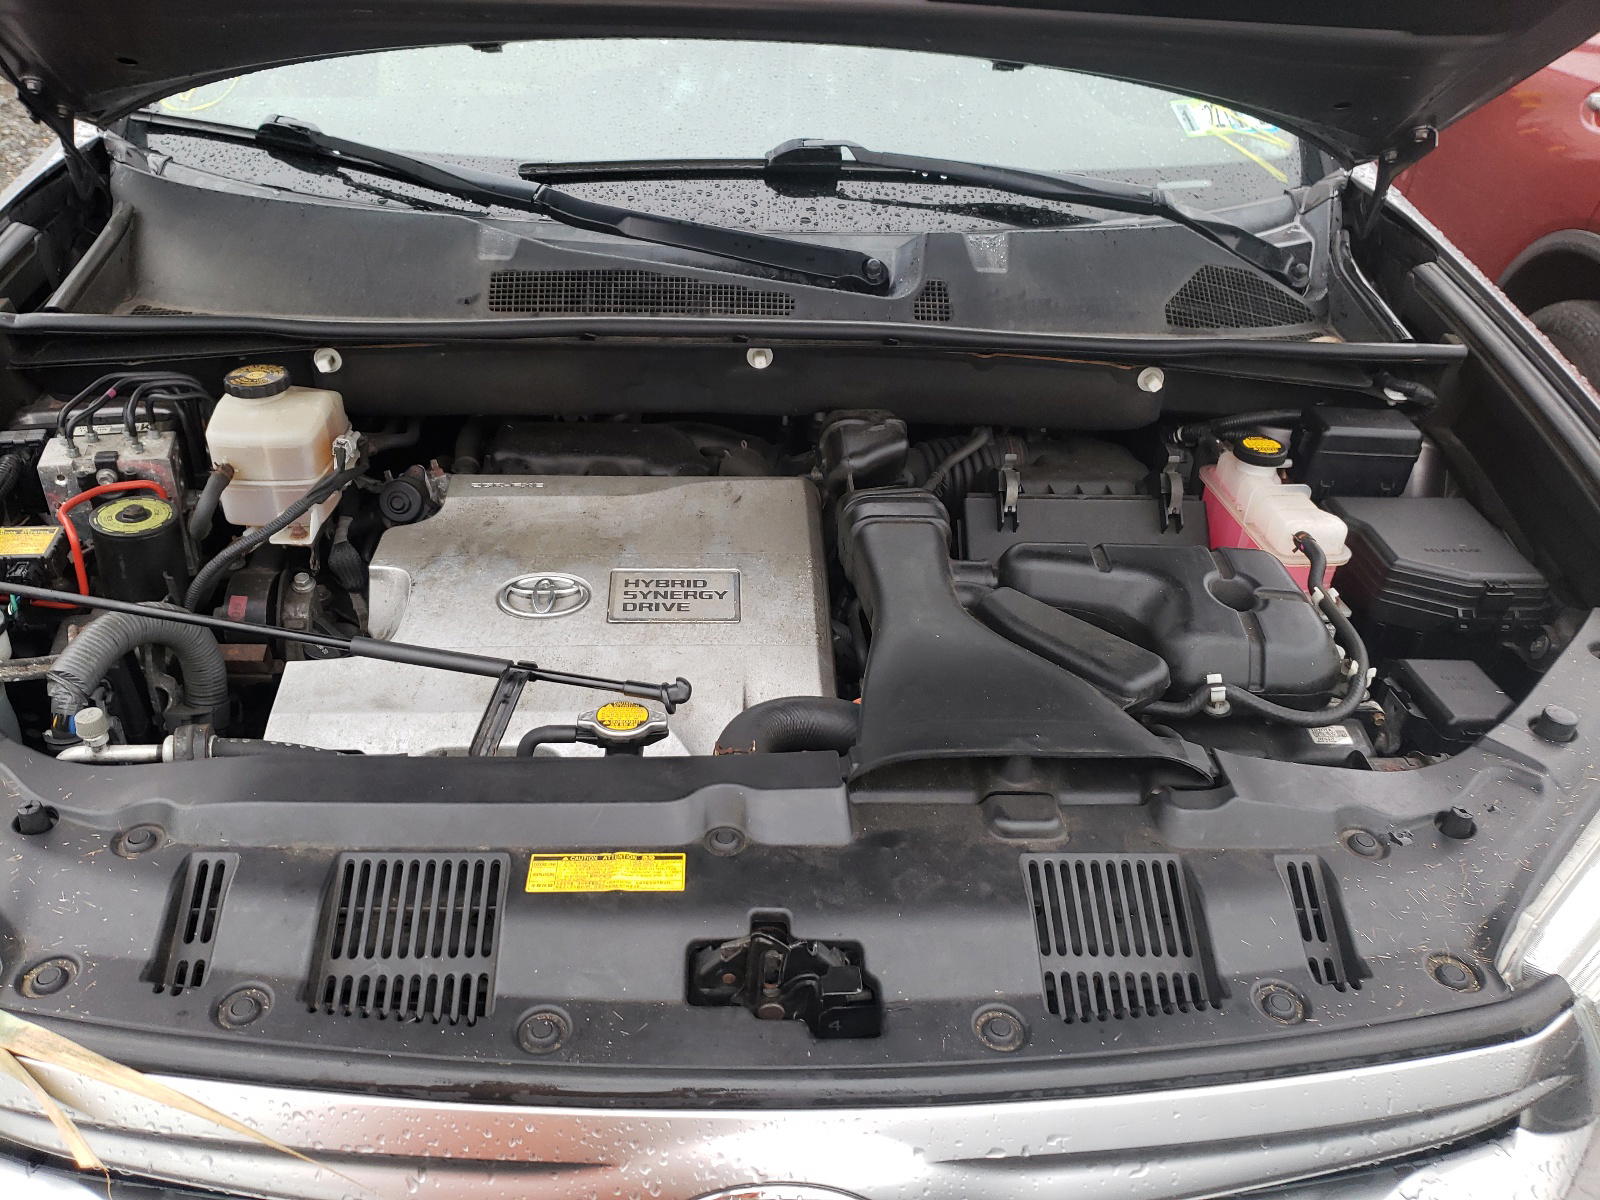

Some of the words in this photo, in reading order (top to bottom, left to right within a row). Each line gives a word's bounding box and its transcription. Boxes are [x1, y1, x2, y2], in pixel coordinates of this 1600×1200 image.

[623, 578, 708, 588] HYBRID
[623, 590, 729, 600] SYNERGY
[622, 602, 691, 612] DRIVE
